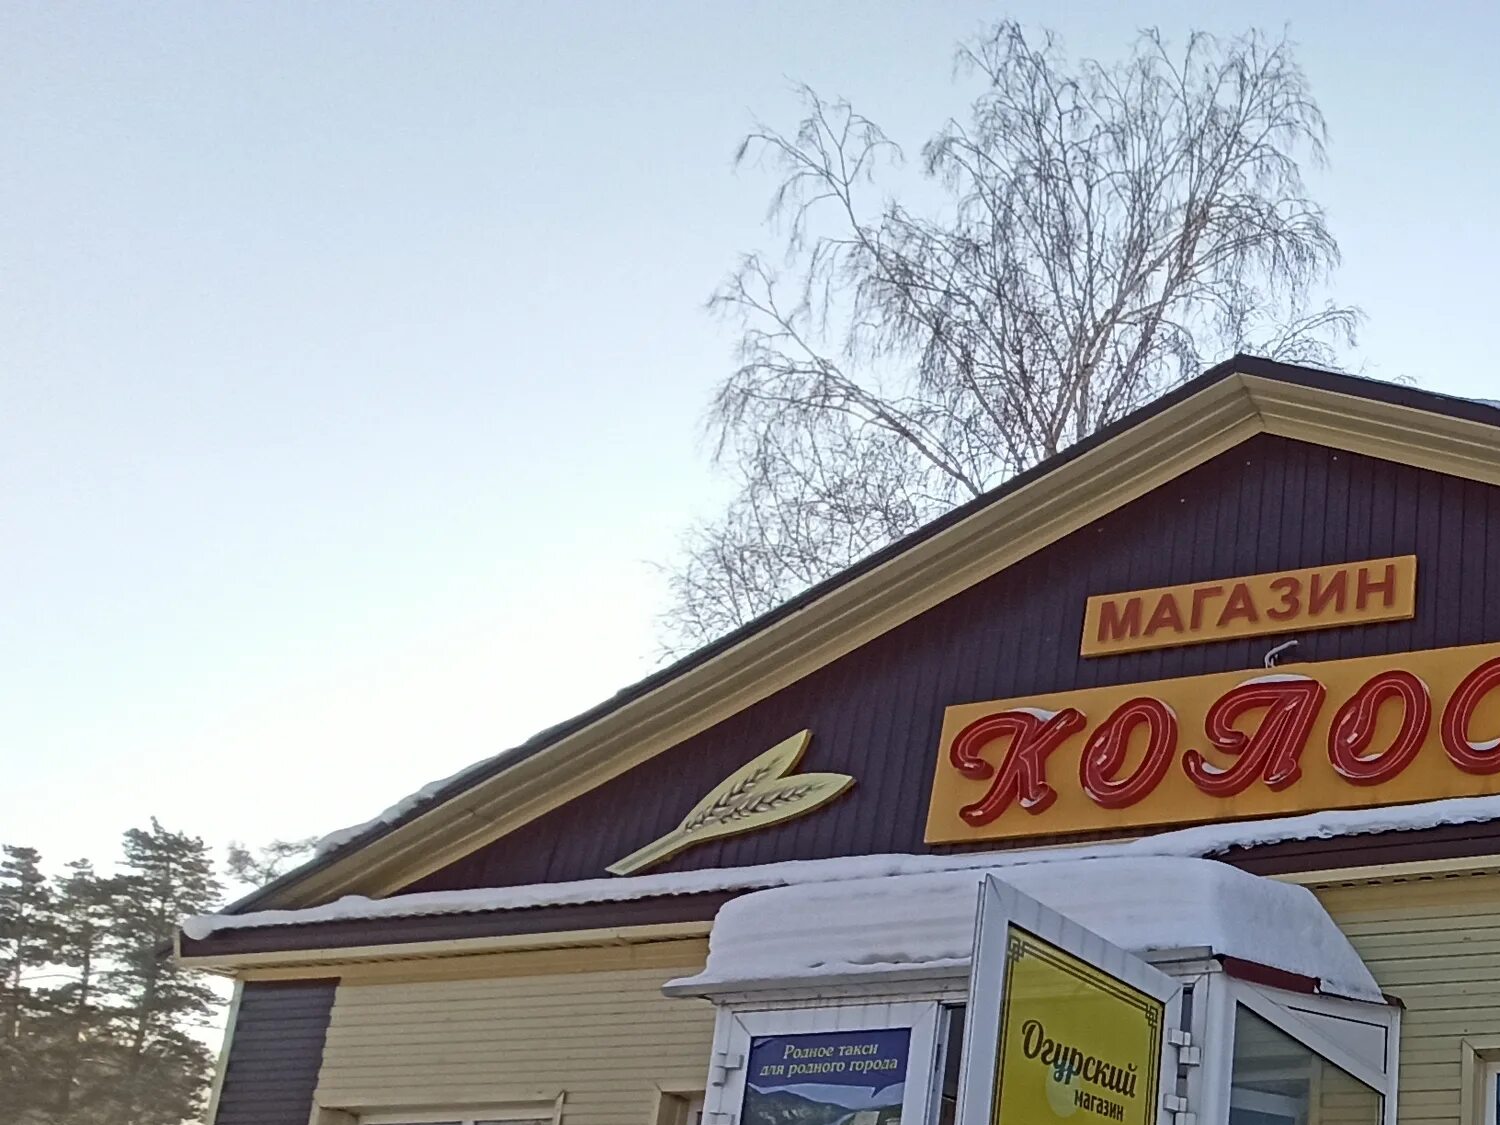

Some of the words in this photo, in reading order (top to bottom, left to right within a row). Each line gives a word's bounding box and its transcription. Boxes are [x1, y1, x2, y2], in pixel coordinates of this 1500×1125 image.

[1097, 563, 1397, 642] МАГАЗИН
[760, 1064, 784, 1076] для
[787, 1061, 845, 1078] родного
[849, 1058, 898, 1074] города
[783, 1044, 834, 1060] Родное
[838, 1043, 879, 1056] такси
[1021, 1019, 1138, 1098] Огурский
[1074, 1089, 1124, 1122] магазин
